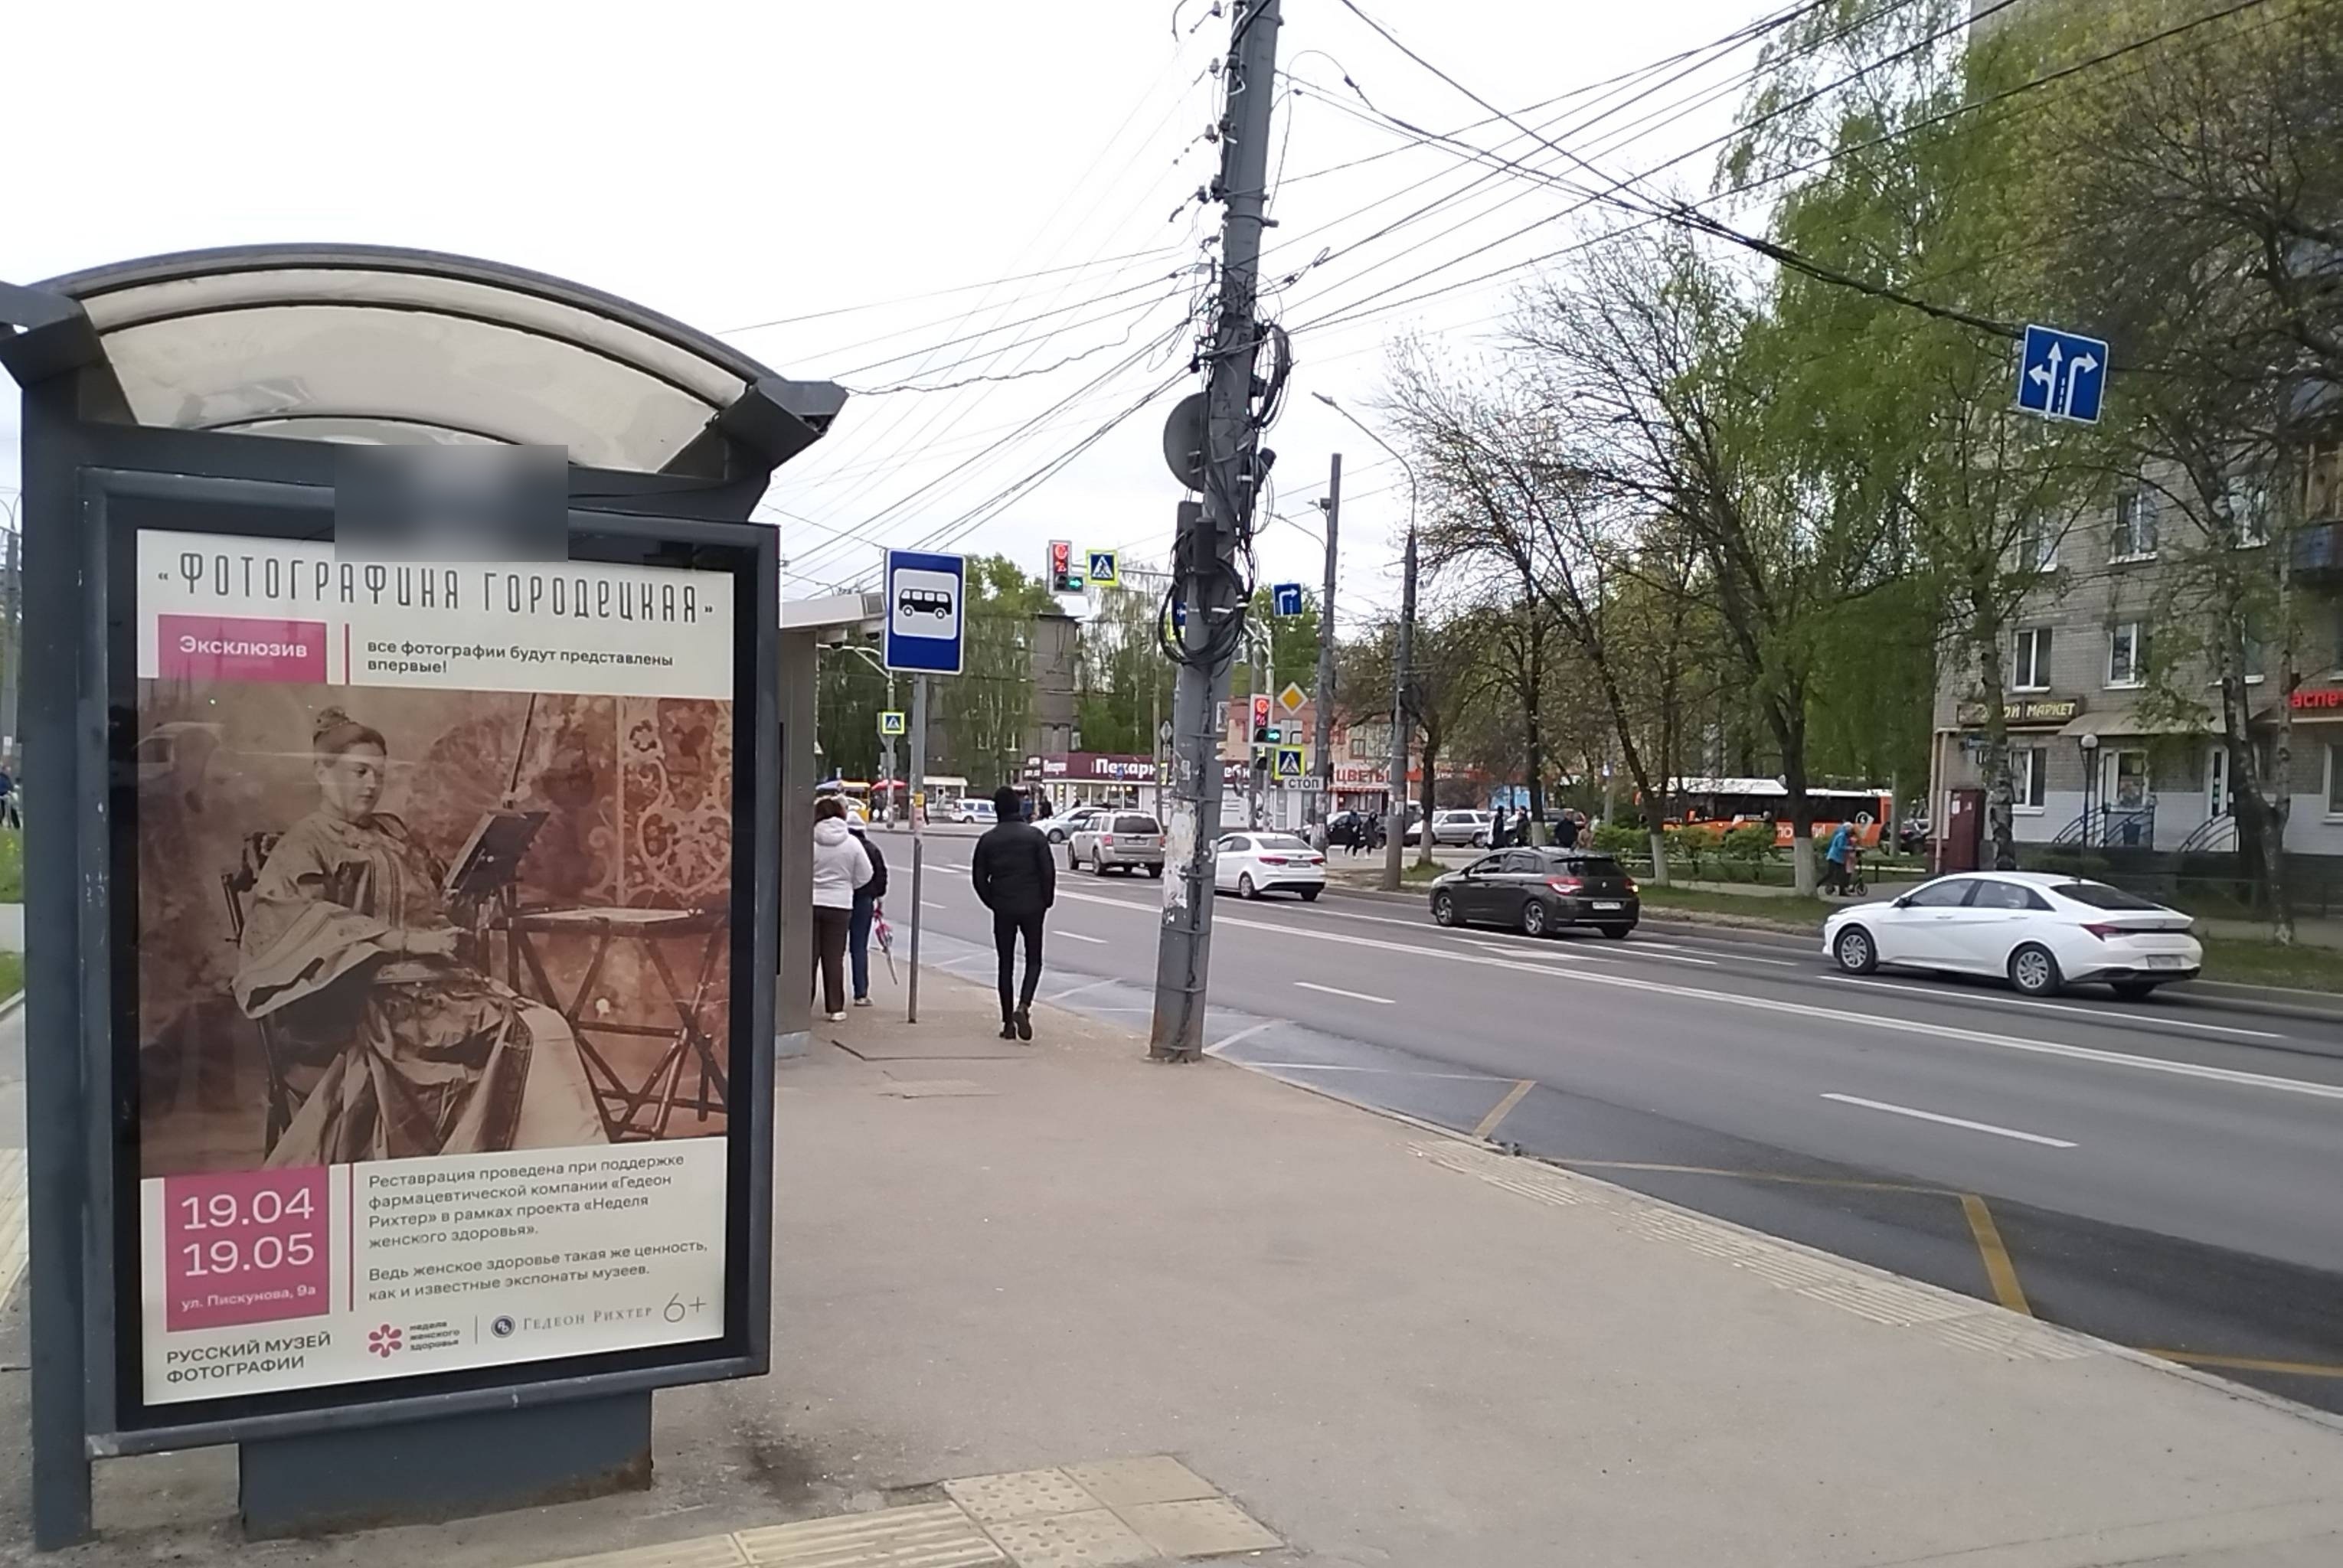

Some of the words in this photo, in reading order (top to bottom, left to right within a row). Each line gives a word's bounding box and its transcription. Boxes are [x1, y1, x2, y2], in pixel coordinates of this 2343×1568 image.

[179, 635, 307, 658] Эксклюзив
[368, 642, 397, 653] все
[401, 641, 505, 659] фотографии
[510, 646, 556, 663] будут
[560, 650, 673, 666] представлены
[368, 659, 447, 675] впервые!
[2026, 702, 2076, 718] МАРКЕТ
[2291, 691, 2343, 707] аспе
[1096, 759, 1156, 779] Пекарн
[1336, 769, 1389, 782] ЦВЕТЫ
[1289, 778, 1319, 789] СТОП
[369, 1171, 475, 1187] Реставрация
[479, 1164, 564, 1181] проведена
[568, 1161, 596, 1174] при
[601, 1155, 684, 1171] поддержке
[369, 1184, 526, 1210] фармацевтической
[531, 1181, 607, 1196] компании
[612, 1175, 672, 1188] «Гедеон
[181, 1187, 314, 1230] 19.04
[369, 1214, 436, 1228] Рихтер»
[442, 1212, 449, 1222] в
[455, 1207, 512, 1223] рамках
[517, 1203, 580, 1218] проекта
[584, 1196, 649, 1210] «Неделя
[369, 1232, 446, 1249] женского
[452, 1225, 538, 1241] здоровья».
[183, 1233, 314, 1276] 19.05
[369, 1268, 408, 1282] Ведь
[413, 1261, 482, 1276] женское
[487, 1256, 560, 1270] здоровье
[564, 1250, 606, 1263] такая
[610, 1248, 630, 1258] же
[635, 1241, 707, 1257] ценность,
[369, 1289, 396, 1301] как
[401, 1288, 410, 1297] и
[415, 1279, 500, 1296] известные
[505, 1271, 587, 1288] экспонаты
[592, 1265, 649, 1281] музеев.
[181, 1299, 203, 1312] ул.
[208, 1289, 293, 1307] Пискунова,
[297, 1285, 315, 1296] 9а
[664, 1292, 707, 1323] 6+
[167, 1340, 260, 1364] РУССКИЙ
[265, 1331, 331, 1353] МУЗЕЙ
[166, 1356, 304, 1383] ФОТОГРАФИИ
